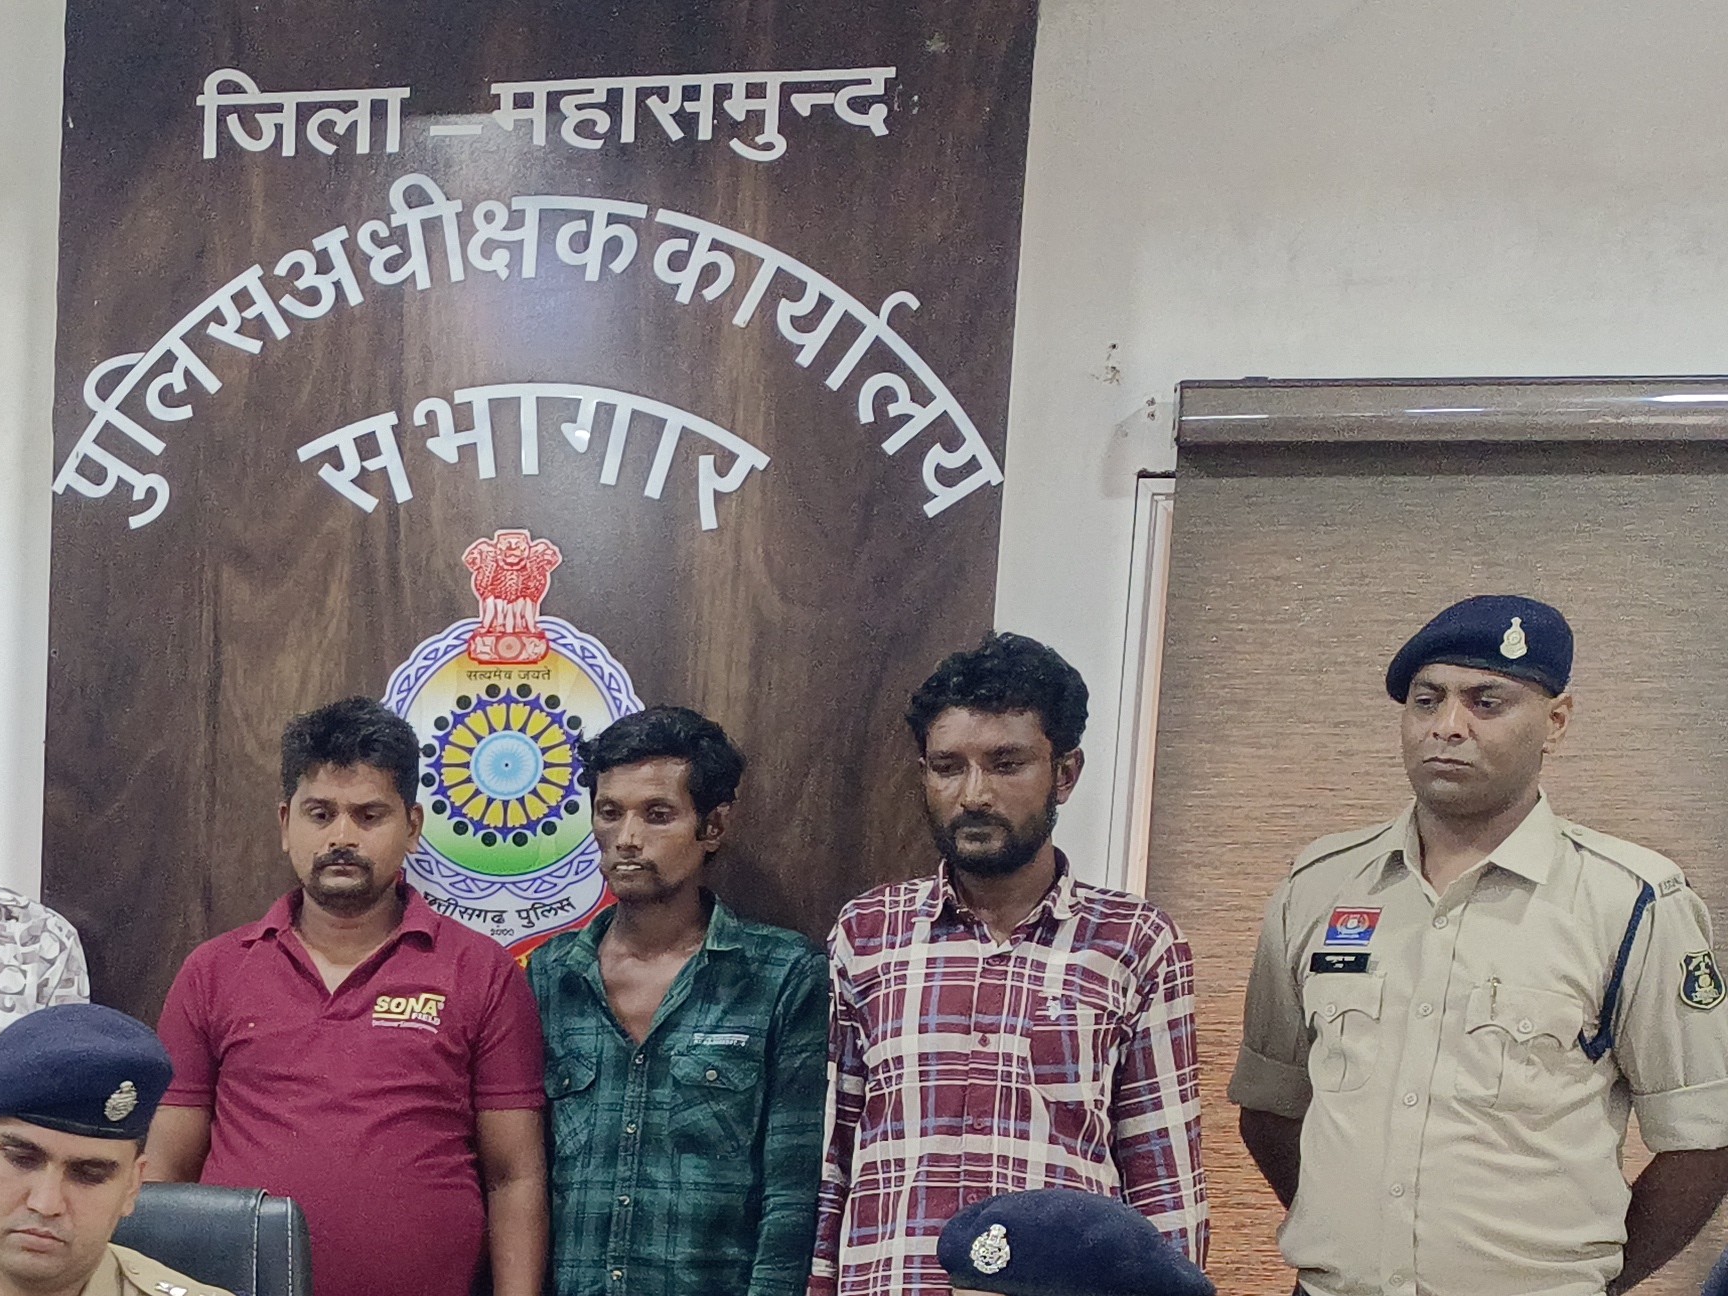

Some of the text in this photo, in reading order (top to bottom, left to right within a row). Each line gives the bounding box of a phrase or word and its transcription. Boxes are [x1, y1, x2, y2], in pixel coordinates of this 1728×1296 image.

[196, 68, 411, 160] जिला
[296, 382, 771, 531] सभागार
[466, 665, 552, 681] सत्यमेव जयते
[515, 895, 576, 929] पुलिस
[372, 993, 446, 1020] SONA
